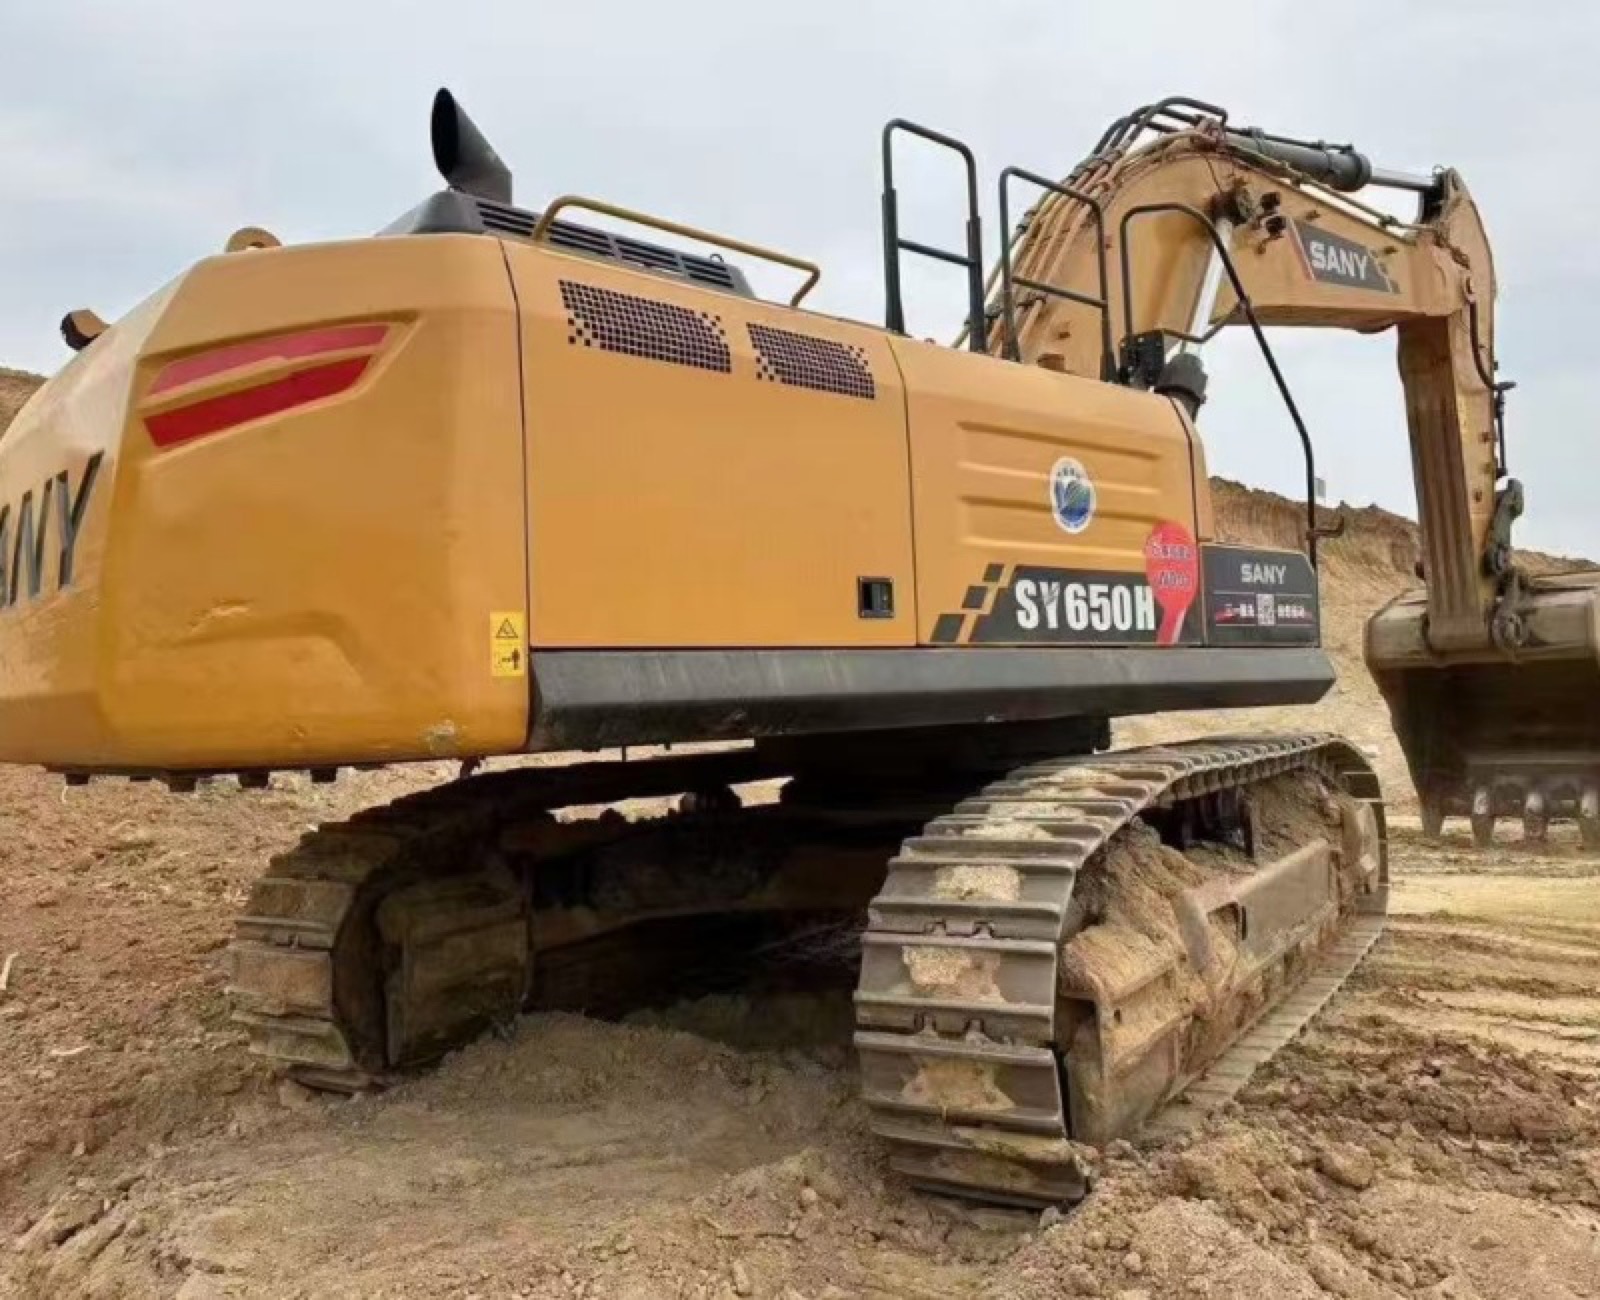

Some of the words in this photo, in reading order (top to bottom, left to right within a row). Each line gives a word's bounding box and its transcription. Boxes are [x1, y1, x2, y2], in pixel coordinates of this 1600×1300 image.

[1310, 241, 1368, 280] SANY
[1241, 563, 1287, 584] SANY
[1015, 579, 1155, 631] SY650H
